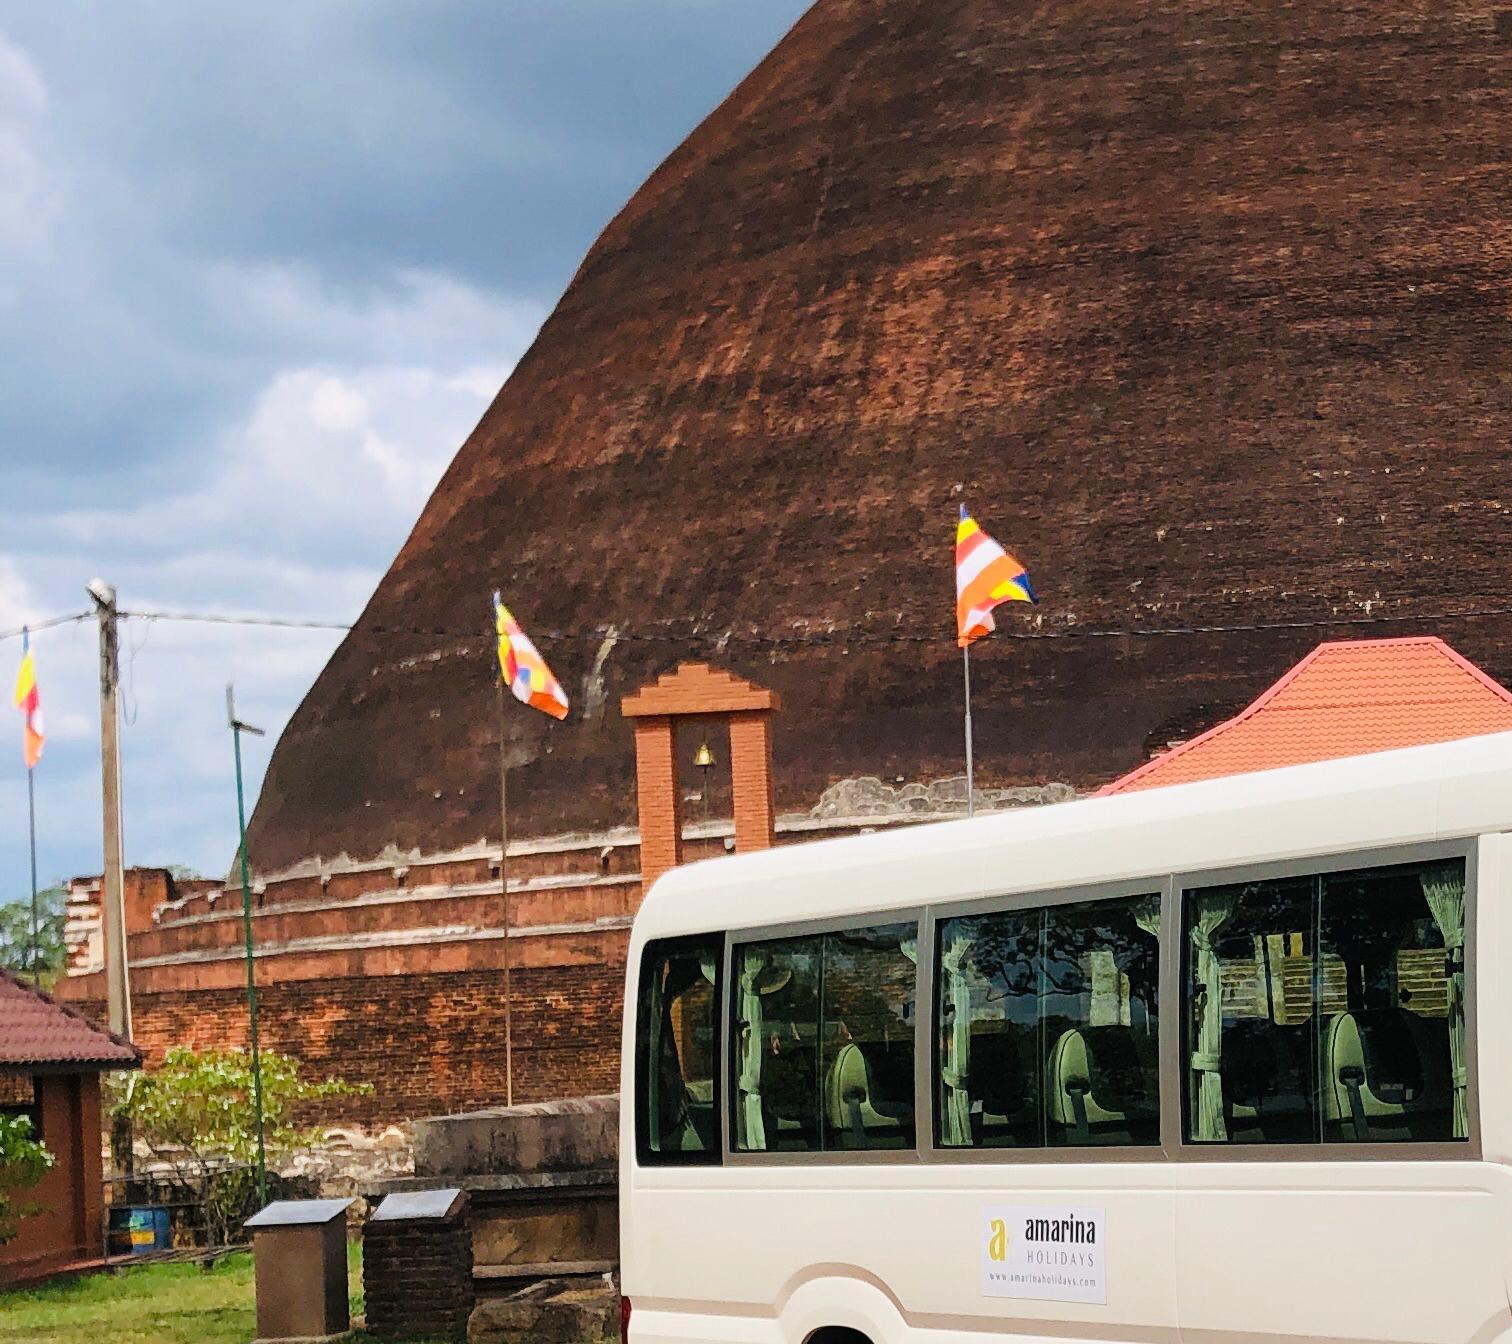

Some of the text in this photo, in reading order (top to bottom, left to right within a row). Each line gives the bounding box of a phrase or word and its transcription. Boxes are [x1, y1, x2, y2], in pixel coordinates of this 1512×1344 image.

[989, 1217, 1007, 1261] a
[1025, 1213, 1096, 1244] amarina
[1027, 1250, 1094, 1267] HOLIDAYS
